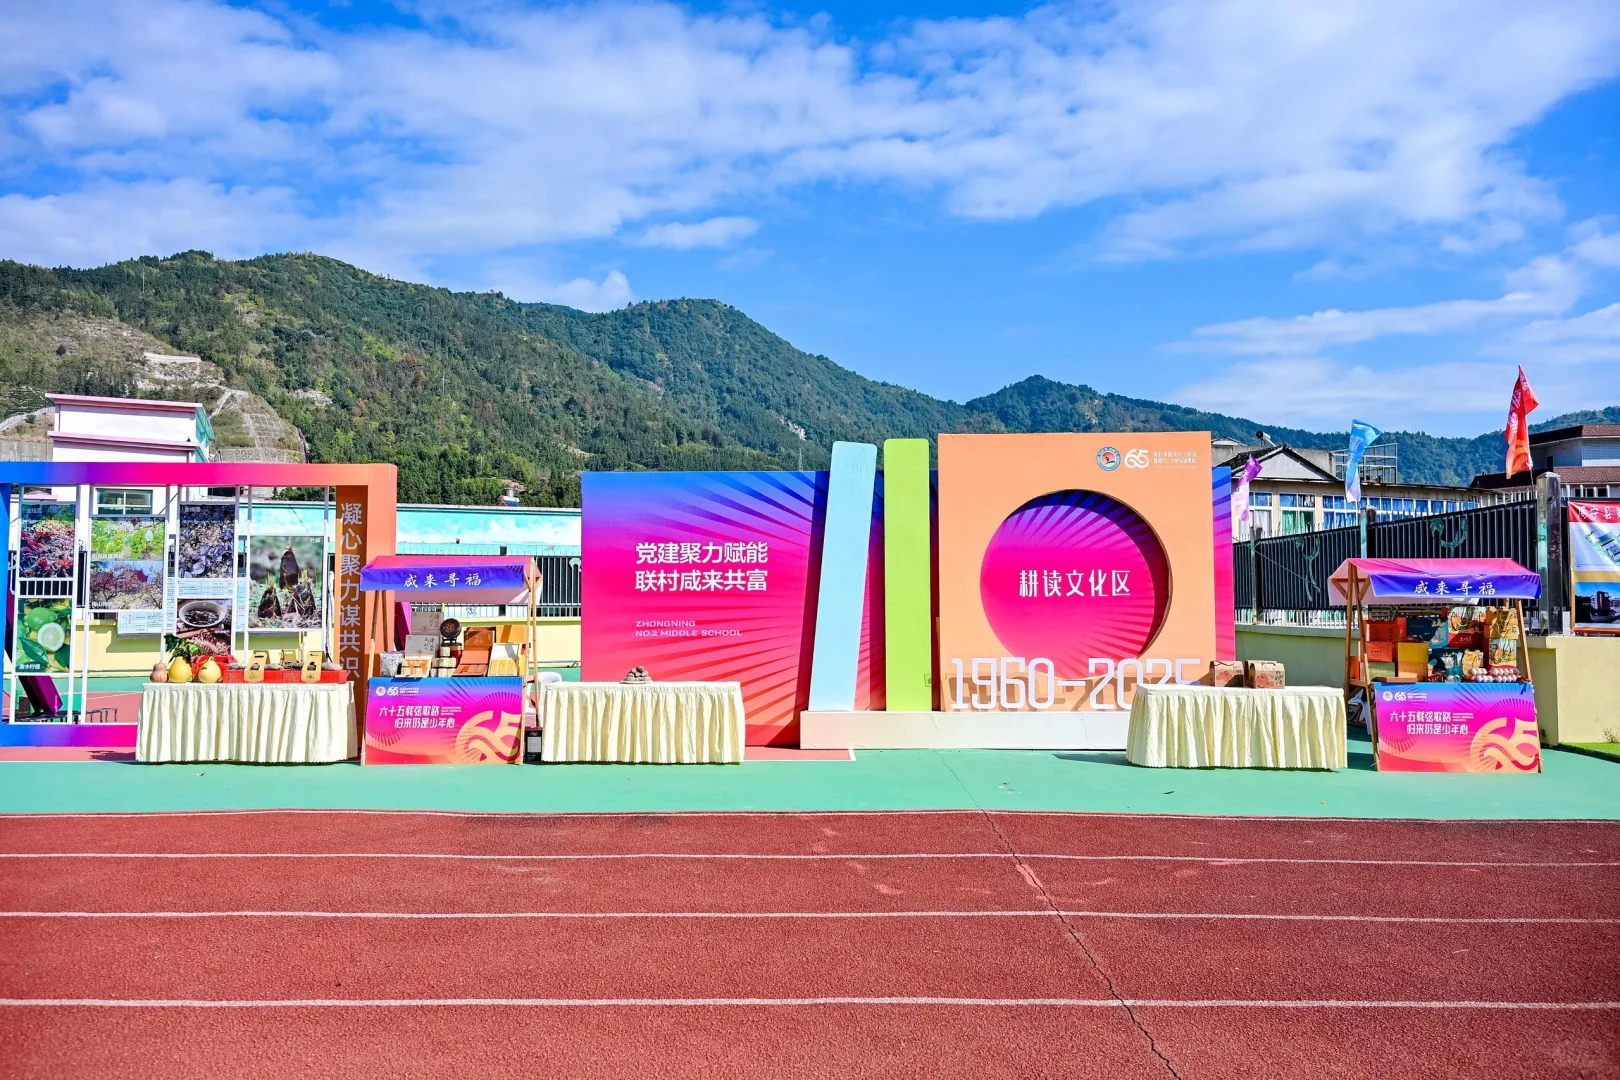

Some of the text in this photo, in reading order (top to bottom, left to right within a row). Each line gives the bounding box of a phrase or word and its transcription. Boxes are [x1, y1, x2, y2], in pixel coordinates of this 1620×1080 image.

[635, 541, 768, 564] 党建聚力赋能
[635, 569, 768, 592] 联村咸来共富
[1018, 569, 1131, 597] 耕读文化区
[340, 502, 363, 679] 凝心聚力谋共识
[635, 620, 696, 628] ZHONGNING
[635, 629, 743, 637] NO.2 MIDDLE SCHOOL
[394, 717, 455, 729] 归来仍是少年心
[1407, 723, 1468, 735] 归来仍是少年心
